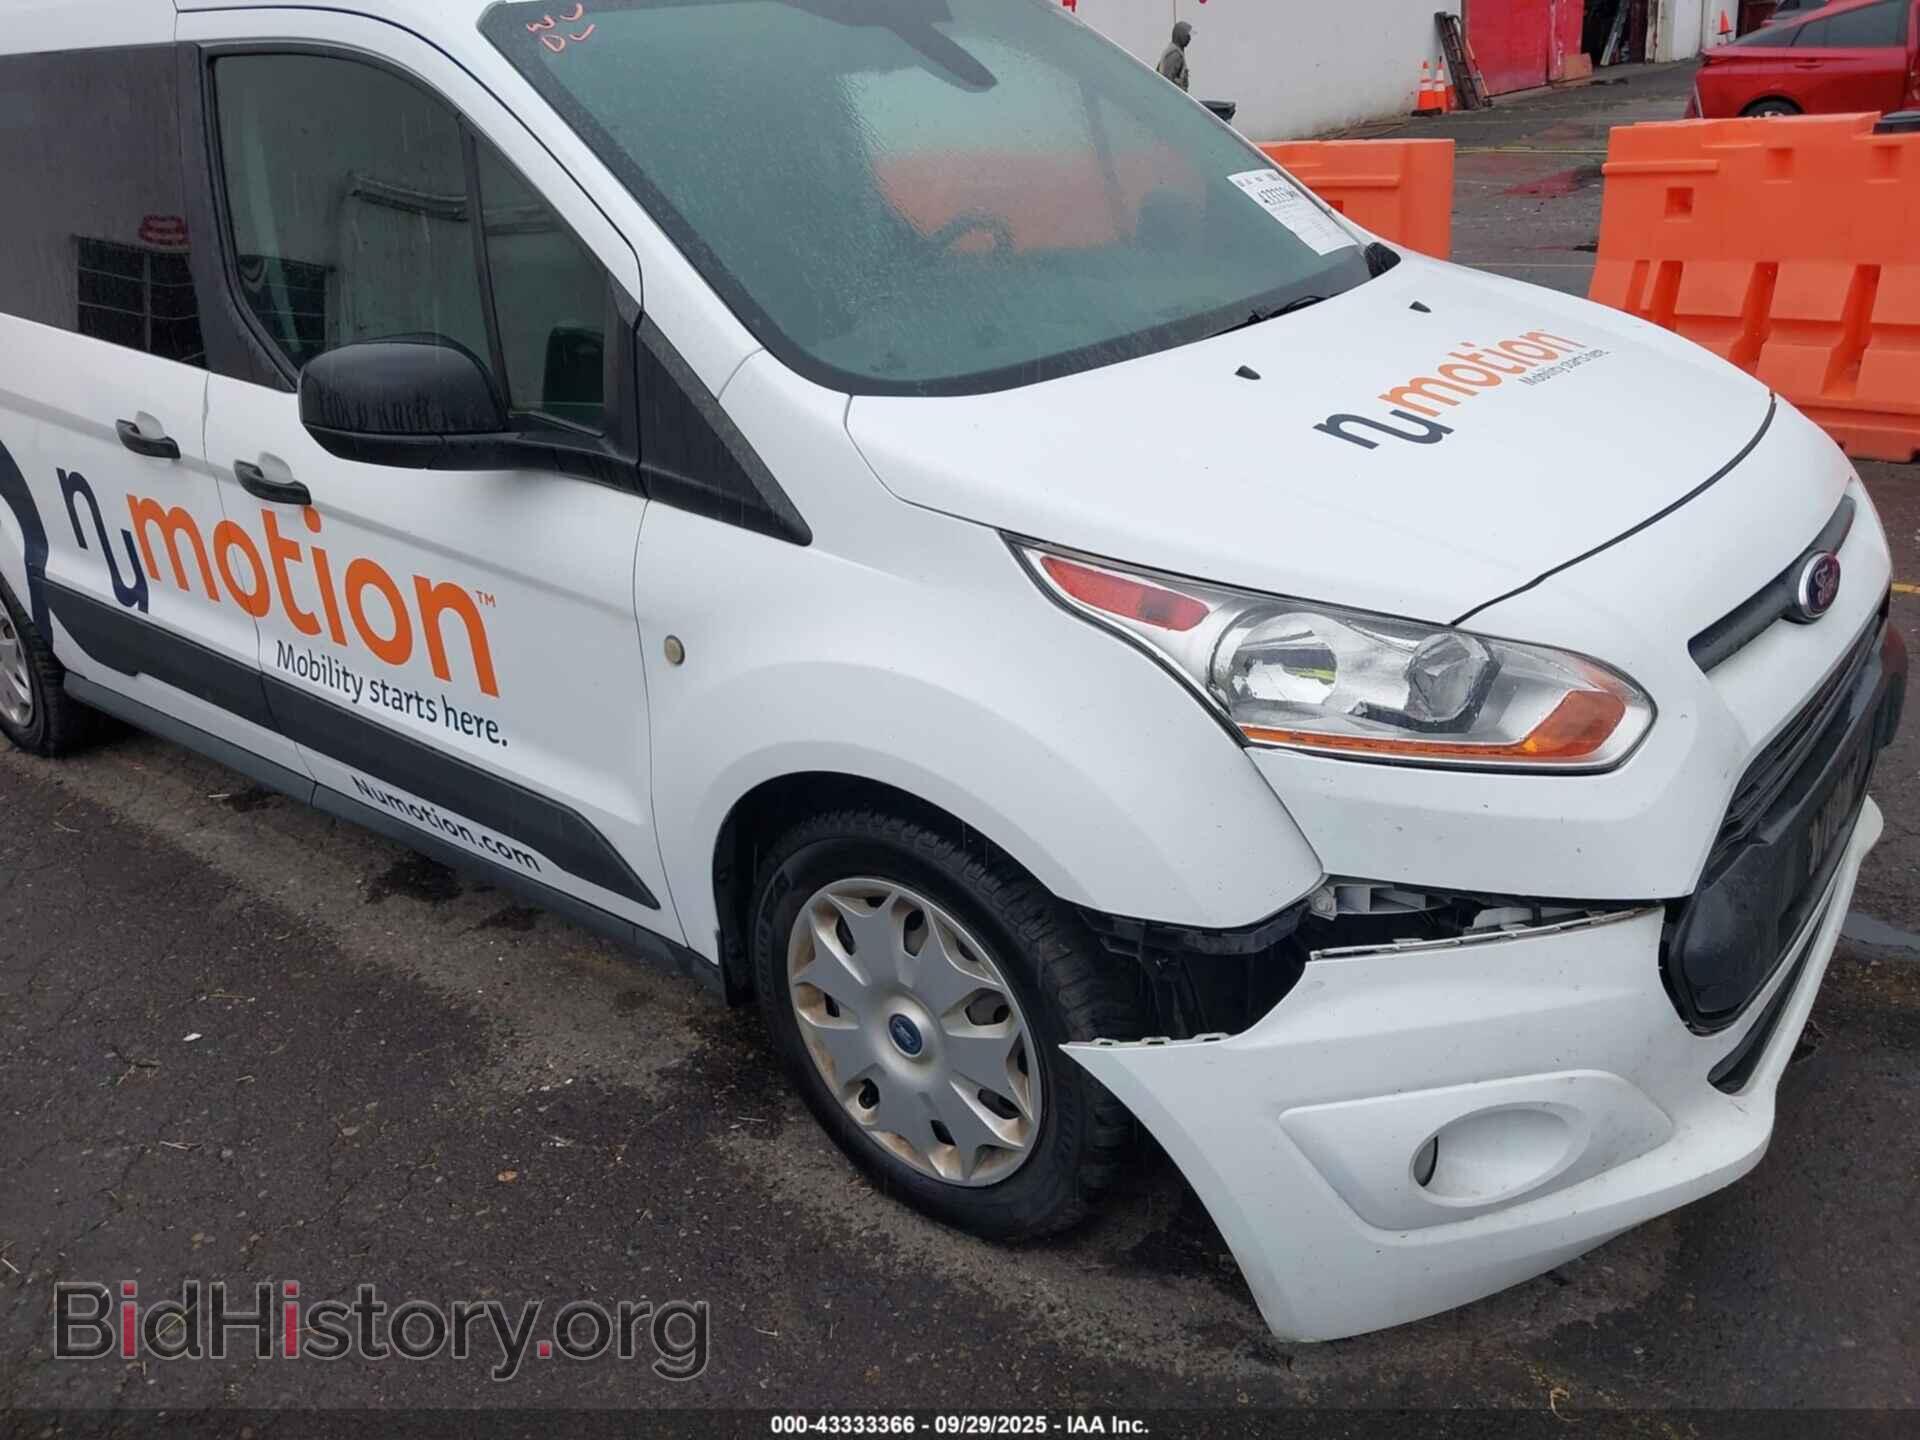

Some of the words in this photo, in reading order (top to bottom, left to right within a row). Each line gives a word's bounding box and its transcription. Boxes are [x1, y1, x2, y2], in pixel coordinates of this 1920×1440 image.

[276, 639, 363, 705] Mobility
[369, 679, 437, 724] starts
[441, 694, 508, 748] here.
[351, 775, 542, 873] Numotion.com
